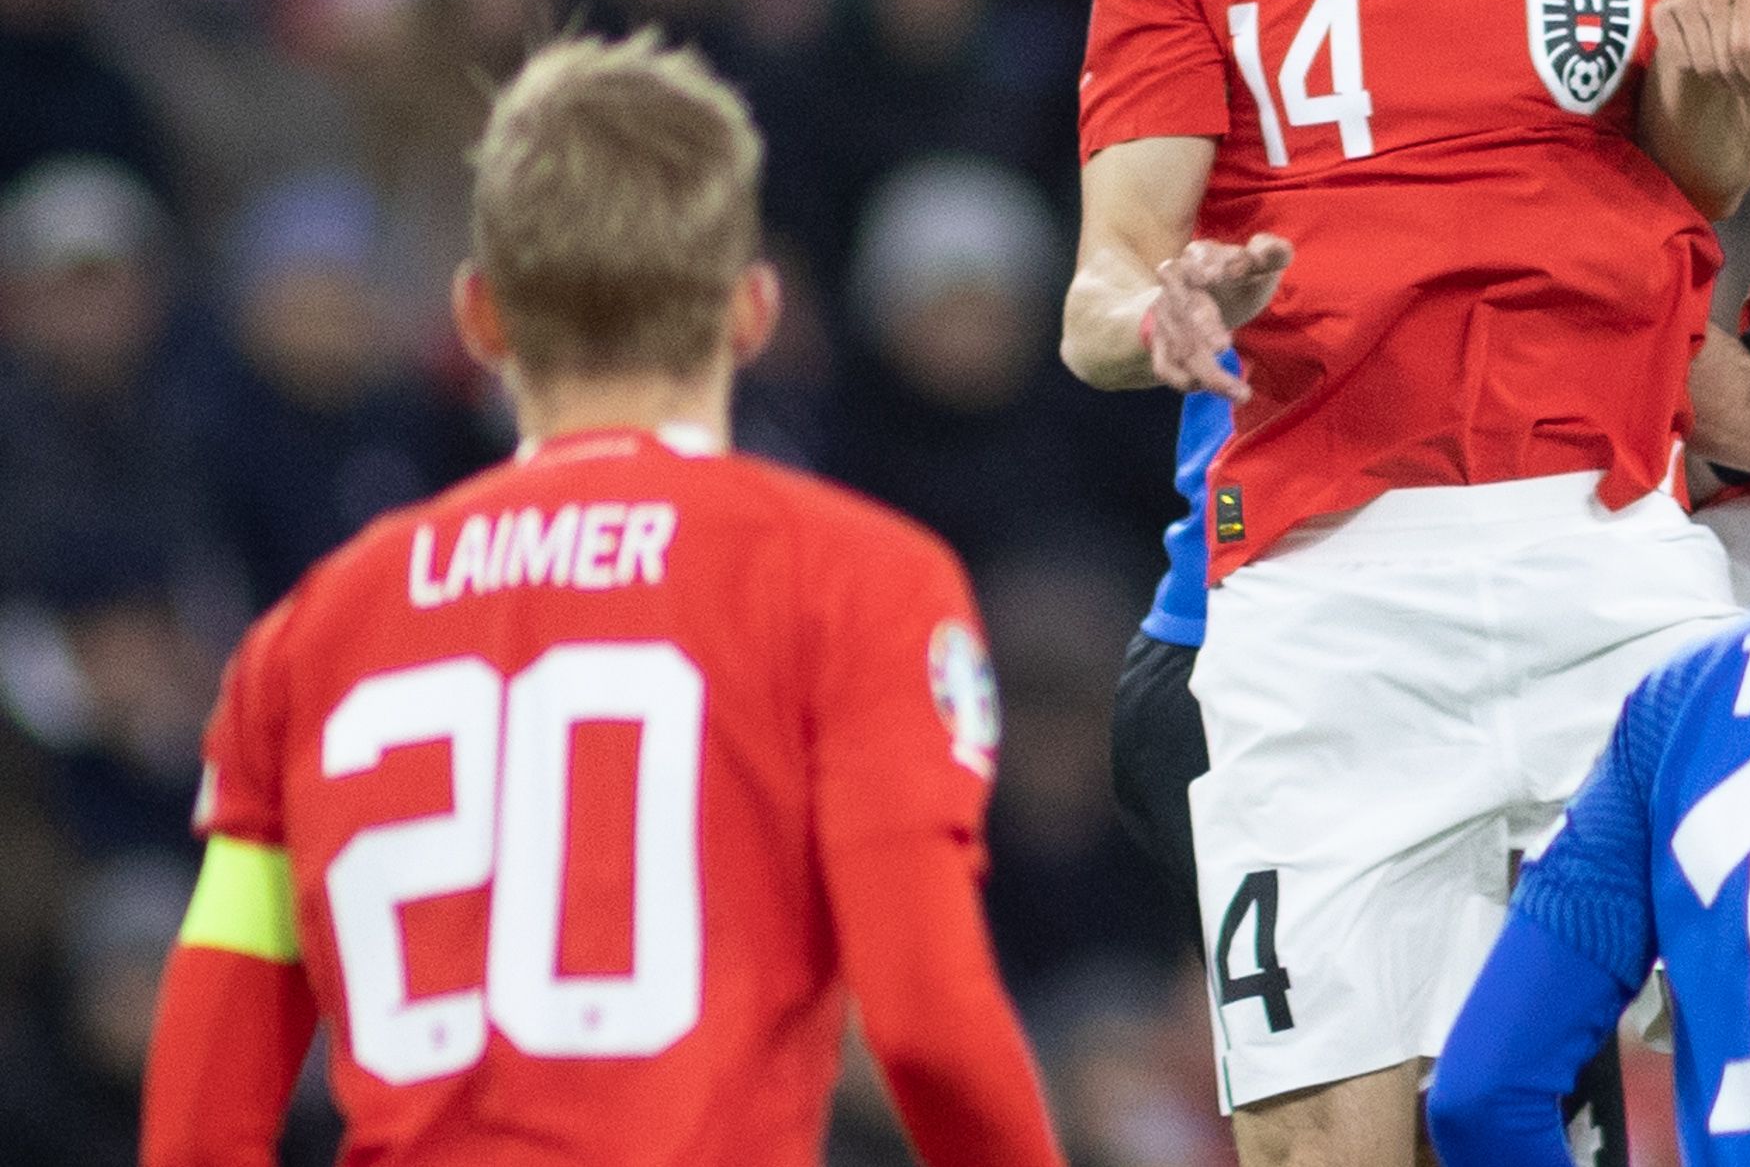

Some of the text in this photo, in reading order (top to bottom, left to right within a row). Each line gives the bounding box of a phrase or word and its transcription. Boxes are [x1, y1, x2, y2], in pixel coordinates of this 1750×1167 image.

[408, 499, 679, 610] LAIMER
[321, 640, 707, 1087] 20
[1215, 868, 1295, 1033] 4
